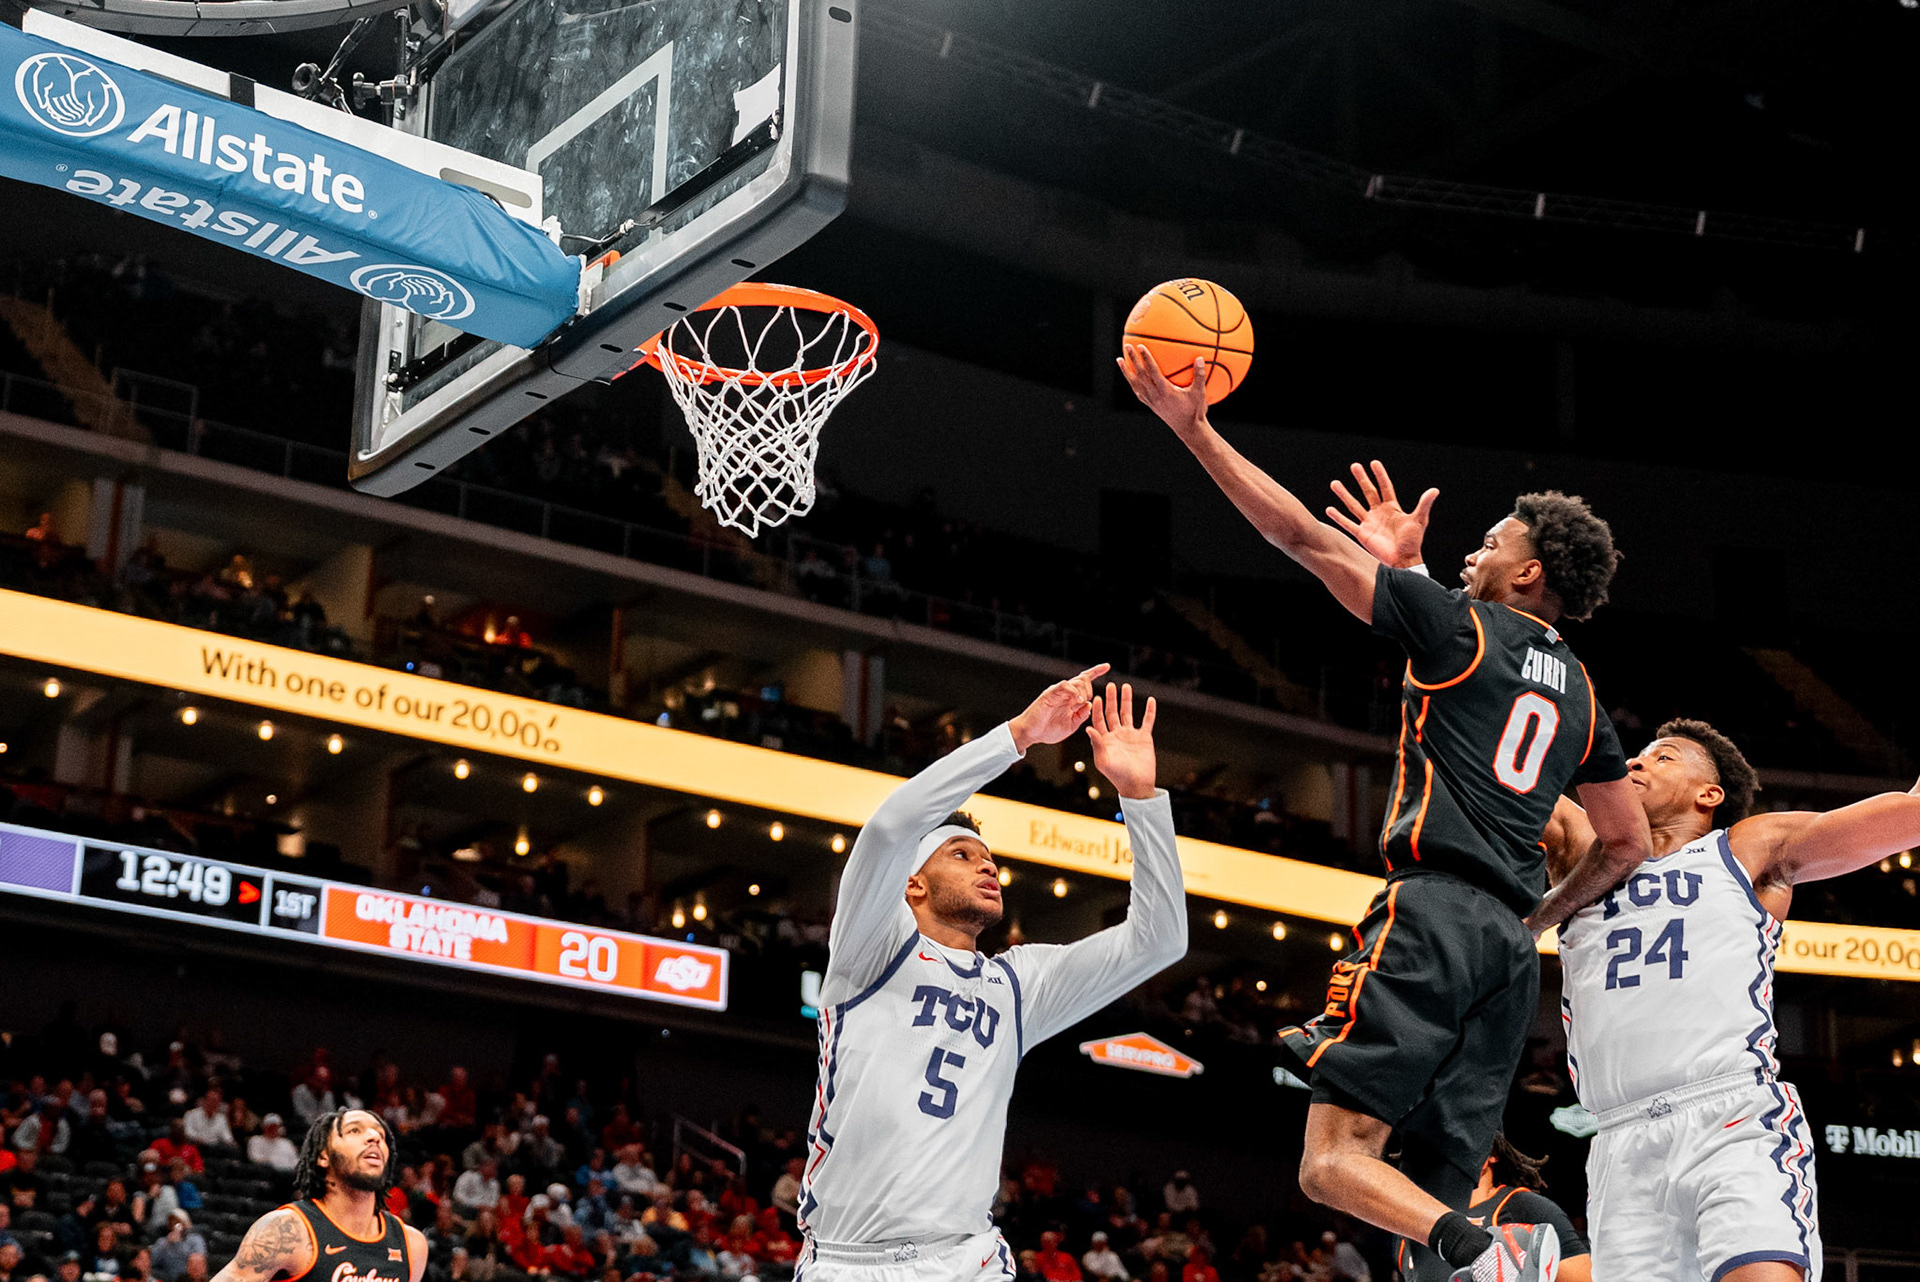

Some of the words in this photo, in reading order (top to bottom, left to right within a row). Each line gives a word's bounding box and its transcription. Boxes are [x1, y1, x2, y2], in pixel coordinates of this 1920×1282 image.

[202, 645, 276, 688] With
[285, 672, 346, 702] one
[355, 683, 389, 710] of
[393, 695, 445, 722] our
[1521, 646, 1567, 694] CURRY
[1492, 690, 1561, 795] 0
[1029, 819, 1109, 860] Edward
[1112, 837, 1134, 864] Jo
[116, 850, 232, 907] 12:49
[274, 889, 317, 919] 1ST
[355, 893, 509, 944] OKLAHOMA
[389, 922, 472, 962] STATE
[559, 931, 618, 982] 20
[1604, 918, 1689, 991] 24
[1794, 939, 1840, 959] our
[911, 985, 1000, 1049] TCU
[917, 1046, 967, 1119] 5
